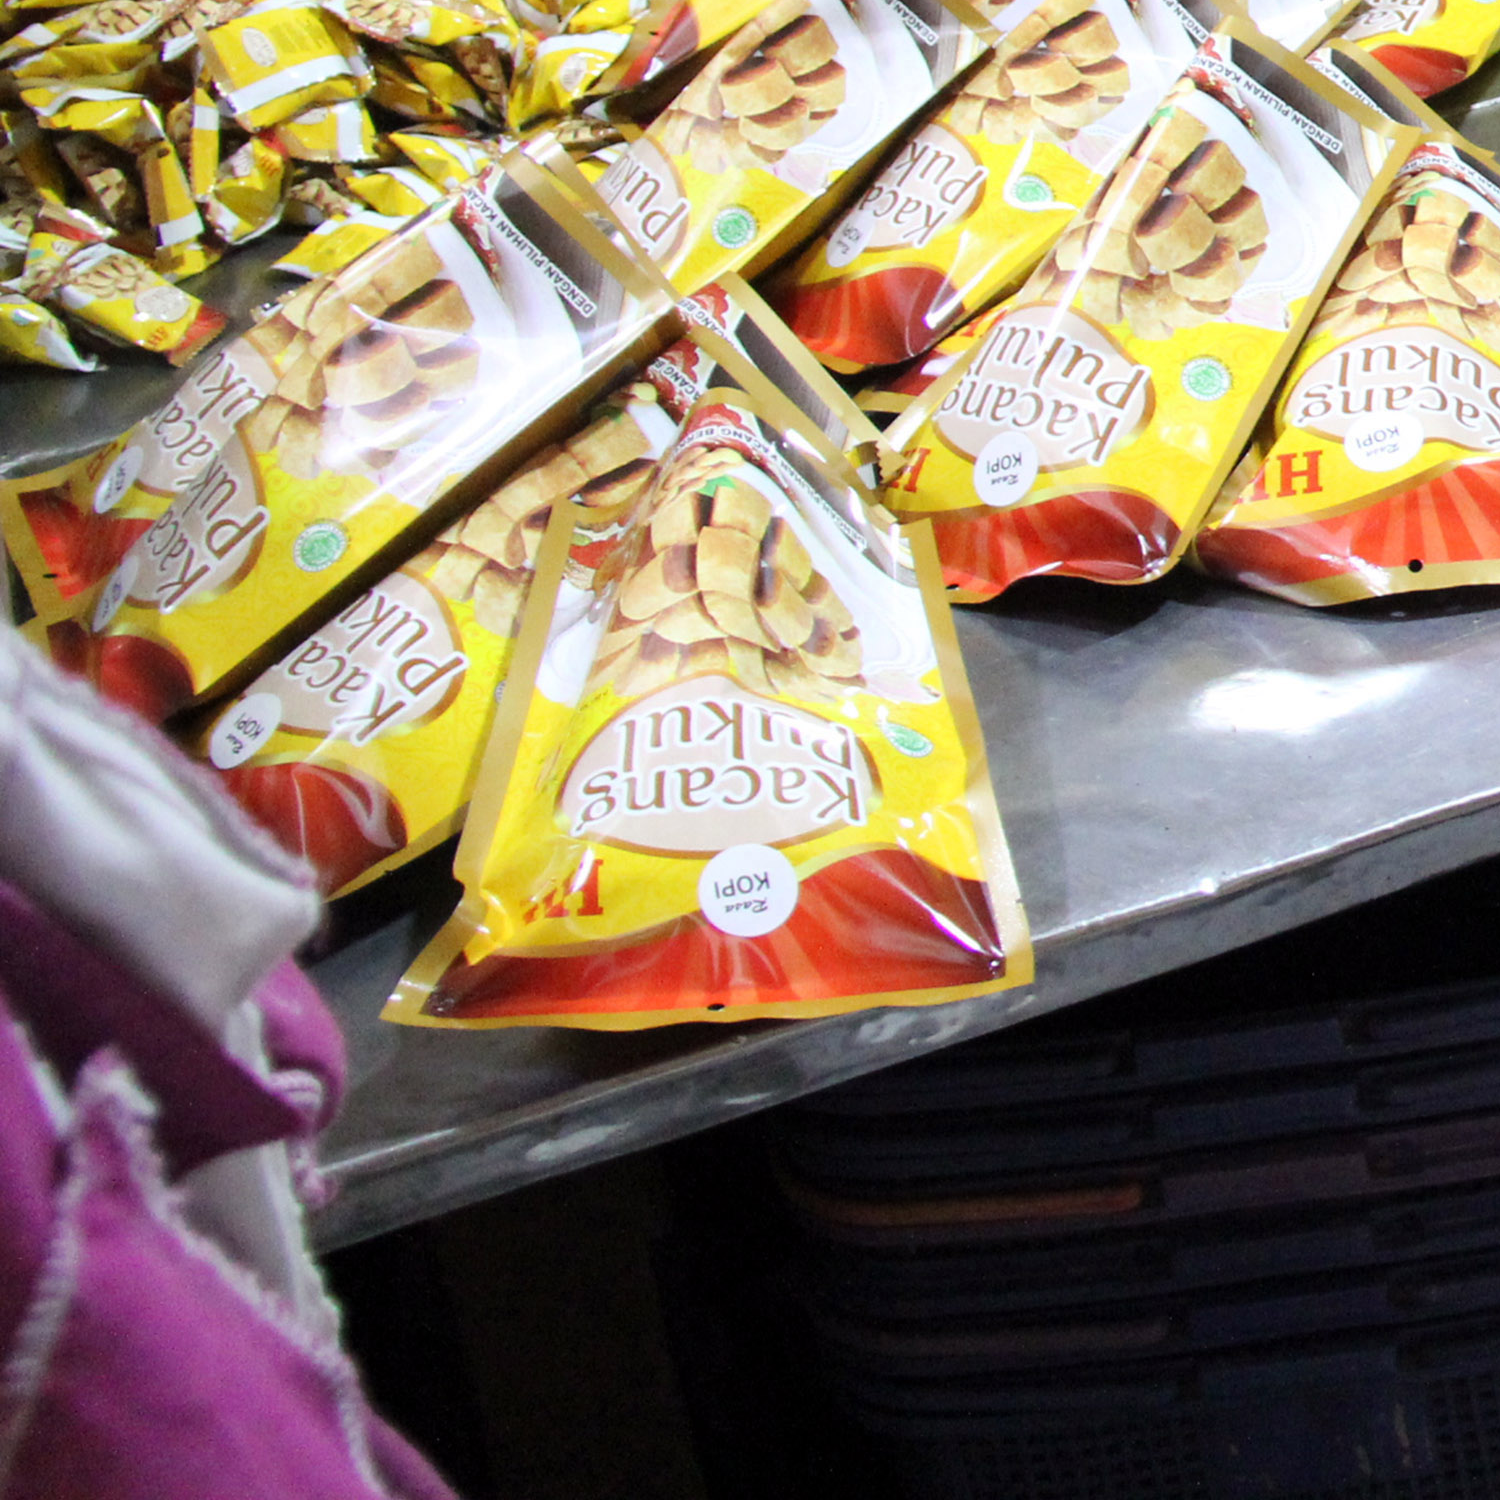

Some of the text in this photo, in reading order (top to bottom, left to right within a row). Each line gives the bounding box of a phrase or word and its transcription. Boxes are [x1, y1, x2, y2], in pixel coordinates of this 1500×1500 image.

[1174, 6, 1206, 40] ENGAN
[1243, 81, 1292, 117] PILIHAN
[1292, 113, 1340, 152] DENGAN
[890, 141, 986, 205] Puk
[858, 184, 948, 245] Kaca
[496, 217, 547, 268] PILIHAN
[543, 266, 595, 316] DENGAN
[1355, 425, 1400, 449] KOPI
[986, 451, 1022, 474] KOPI
[288, 639, 406, 742] Kaca
[235, 712, 265, 740] KOPI
[620, 699, 853, 773] Pukul
[575, 764, 863, 831] Kacang
[713, 870, 771, 899] KOPI
